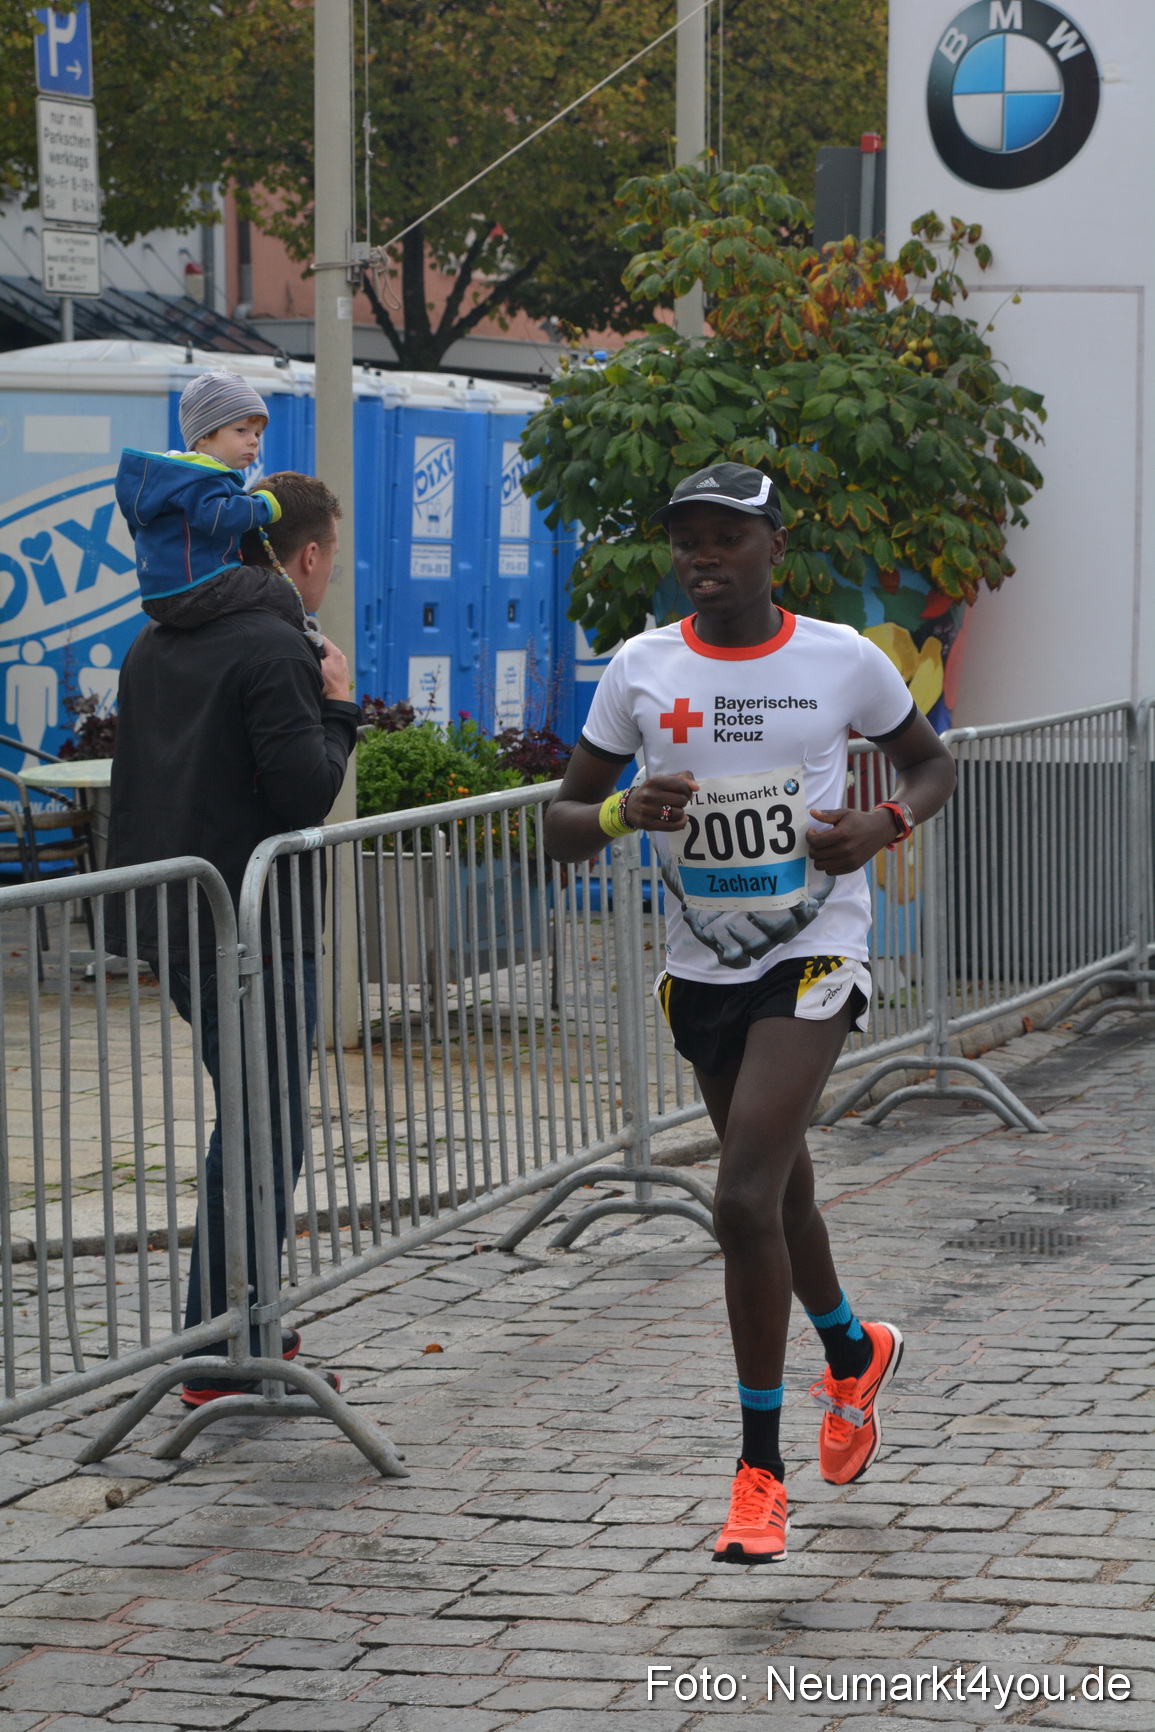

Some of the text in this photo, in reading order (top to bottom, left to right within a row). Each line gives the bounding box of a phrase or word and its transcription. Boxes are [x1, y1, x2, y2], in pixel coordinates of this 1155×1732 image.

[938, 0, 1088, 65] BMW
[50, 112, 84, 127] nur mit
[43, 127, 93, 149] Parkschein
[48, 151, 90, 171] werktags
[714, 695, 818, 713] Bayerisches
[714, 712, 764, 727] Rotes
[714, 728, 764, 743] Kreuz
[708, 785, 778, 805] Neumarkt
[684, 804, 796, 861] 2003
[706, 873, 778, 895] Zachary
